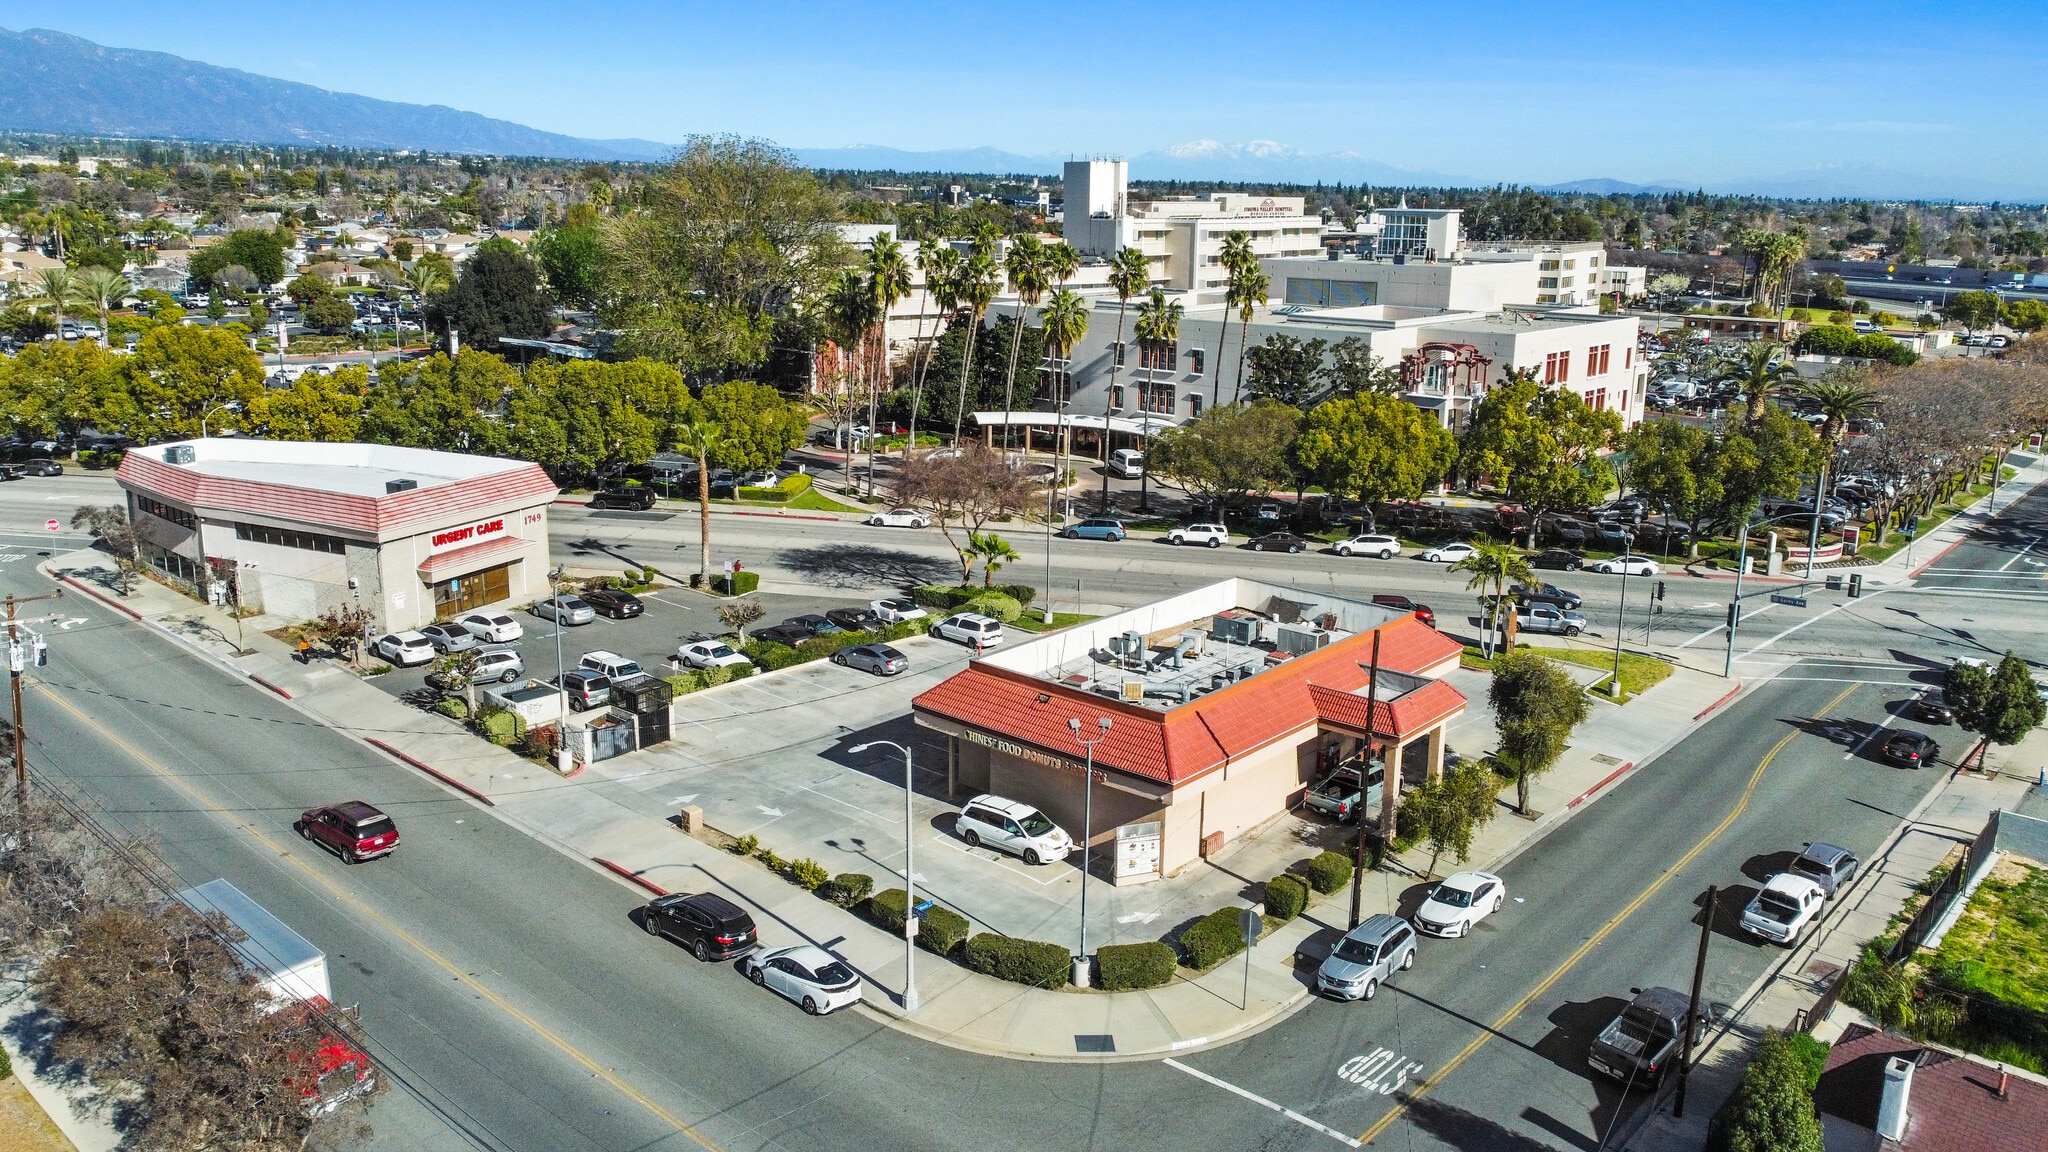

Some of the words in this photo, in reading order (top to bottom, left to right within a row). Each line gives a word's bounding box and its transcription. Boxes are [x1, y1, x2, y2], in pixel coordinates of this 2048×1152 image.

[47, 522, 59, 530] STOP
[432, 526, 474, 547] URGENT
[476, 519, 504, 536] CARE
[523, 513, 542, 526] 1749
[963, 729, 998, 748] CHINESE
[998, 740, 1022, 756] FOOD
[1023, 748, 1062, 769] DONUTS
[1071, 763, 1108, 782] BURERS
[1337, 1046, 1424, 1095] STOP
